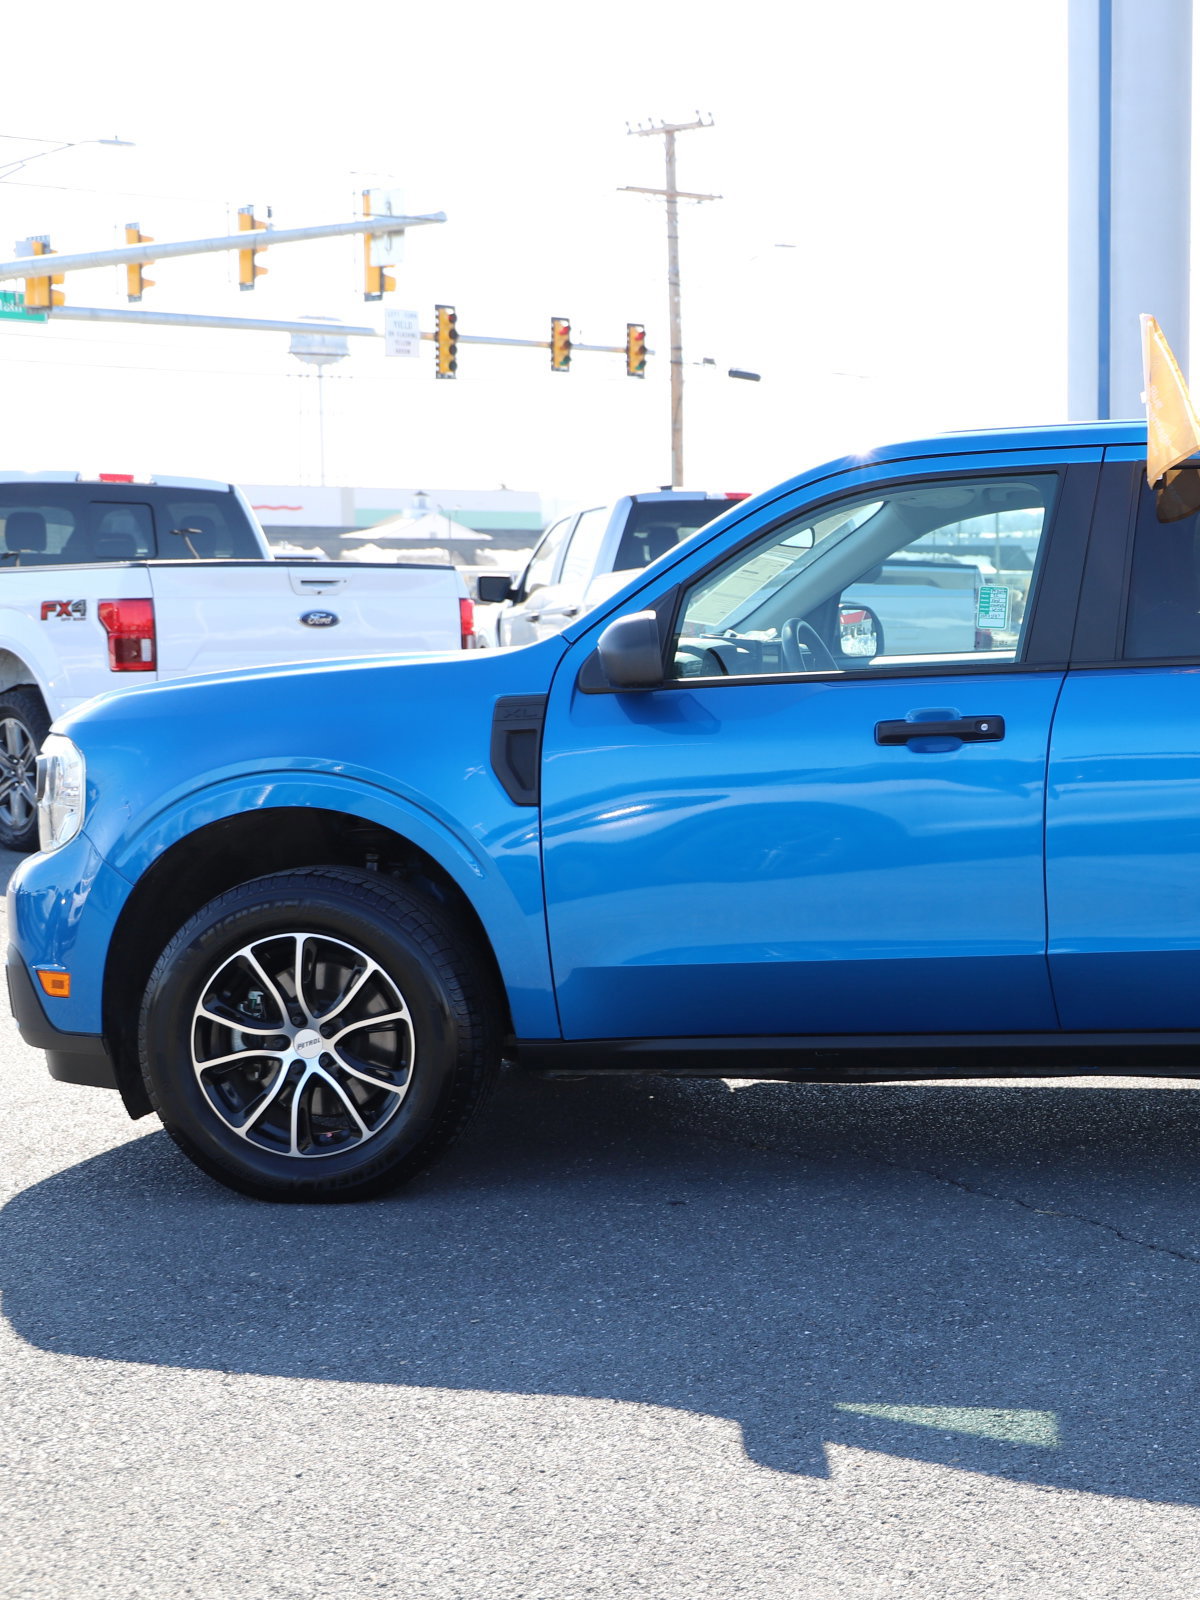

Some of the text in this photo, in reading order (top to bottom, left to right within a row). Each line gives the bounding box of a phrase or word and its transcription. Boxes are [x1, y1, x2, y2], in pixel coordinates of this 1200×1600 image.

[40, 599, 87, 621] FX4
[308, 612, 333, 625] Ford
[296, 1037, 321, 1050] PETROL
